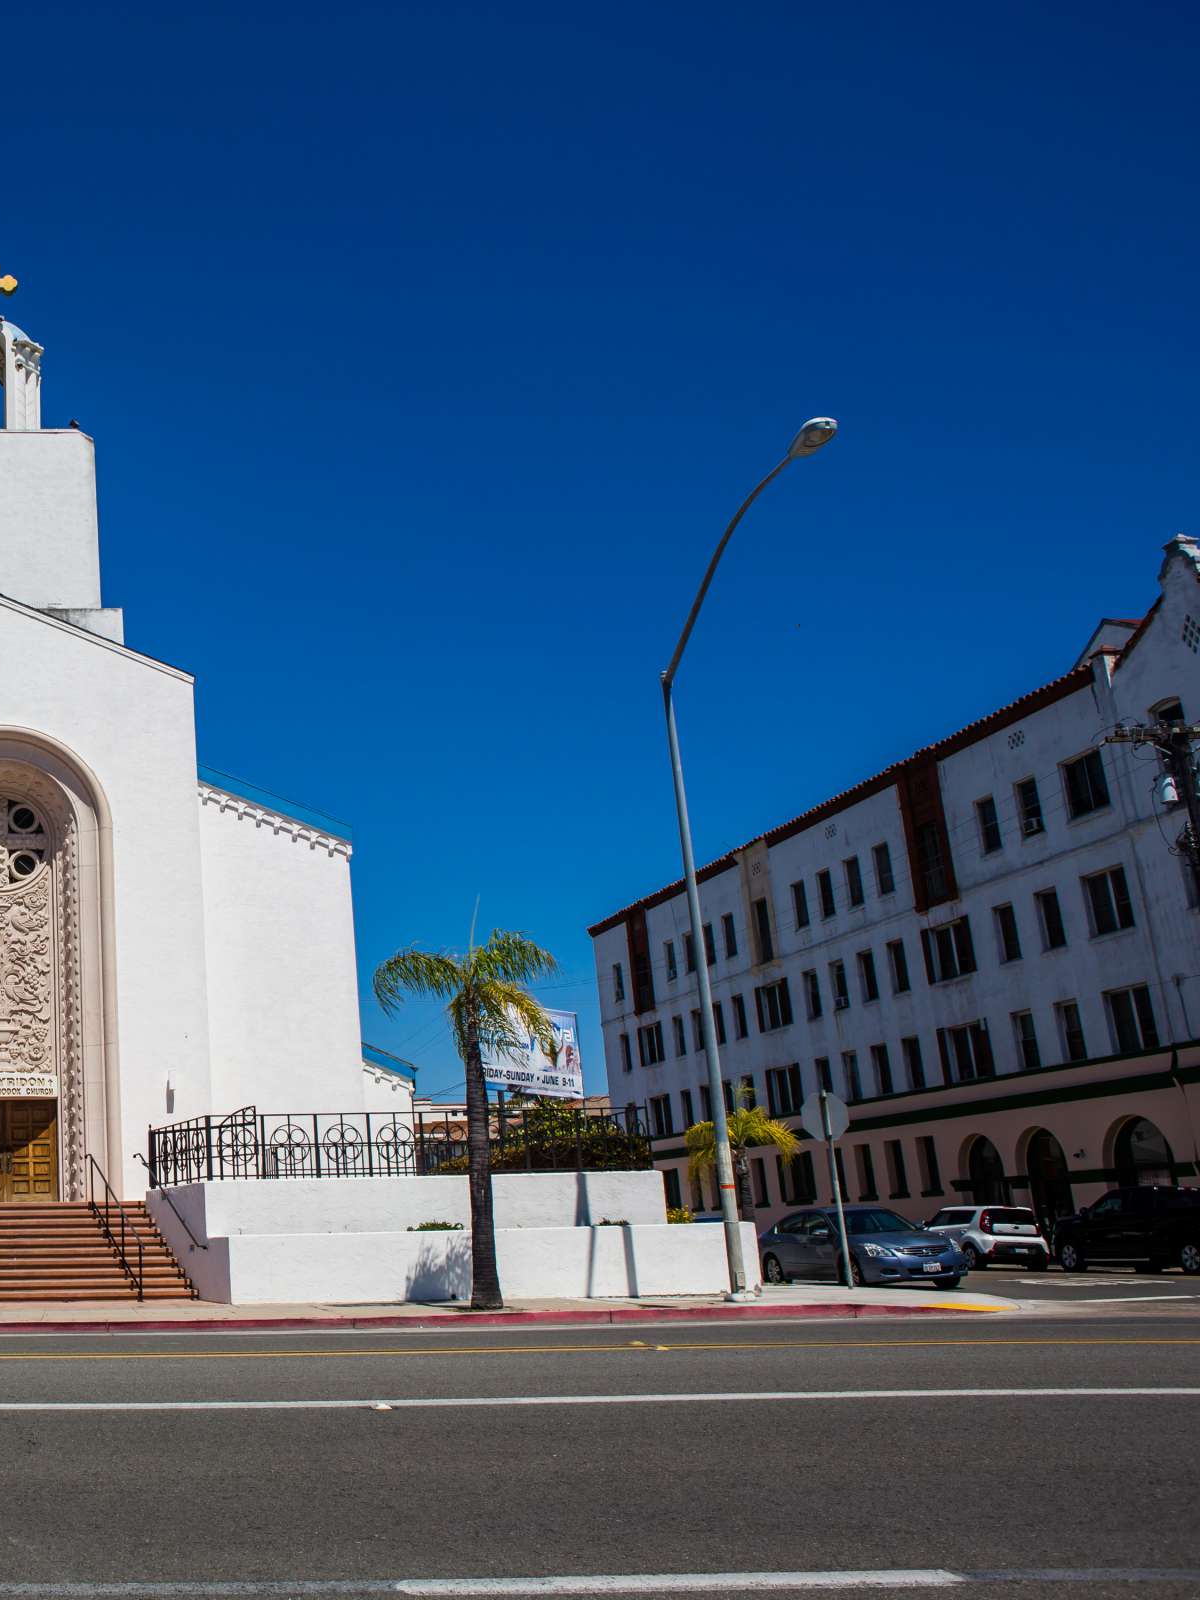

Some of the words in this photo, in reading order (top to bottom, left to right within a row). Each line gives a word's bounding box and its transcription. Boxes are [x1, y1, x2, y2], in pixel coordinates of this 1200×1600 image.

[482, 1067, 535, 1082] RIDAY-SUNDAY
[542, 1075, 559, 1086] JUNE
[562, 1077, 575, 1087] 9-11
[26, 1087, 53, 1095] CHURCH
